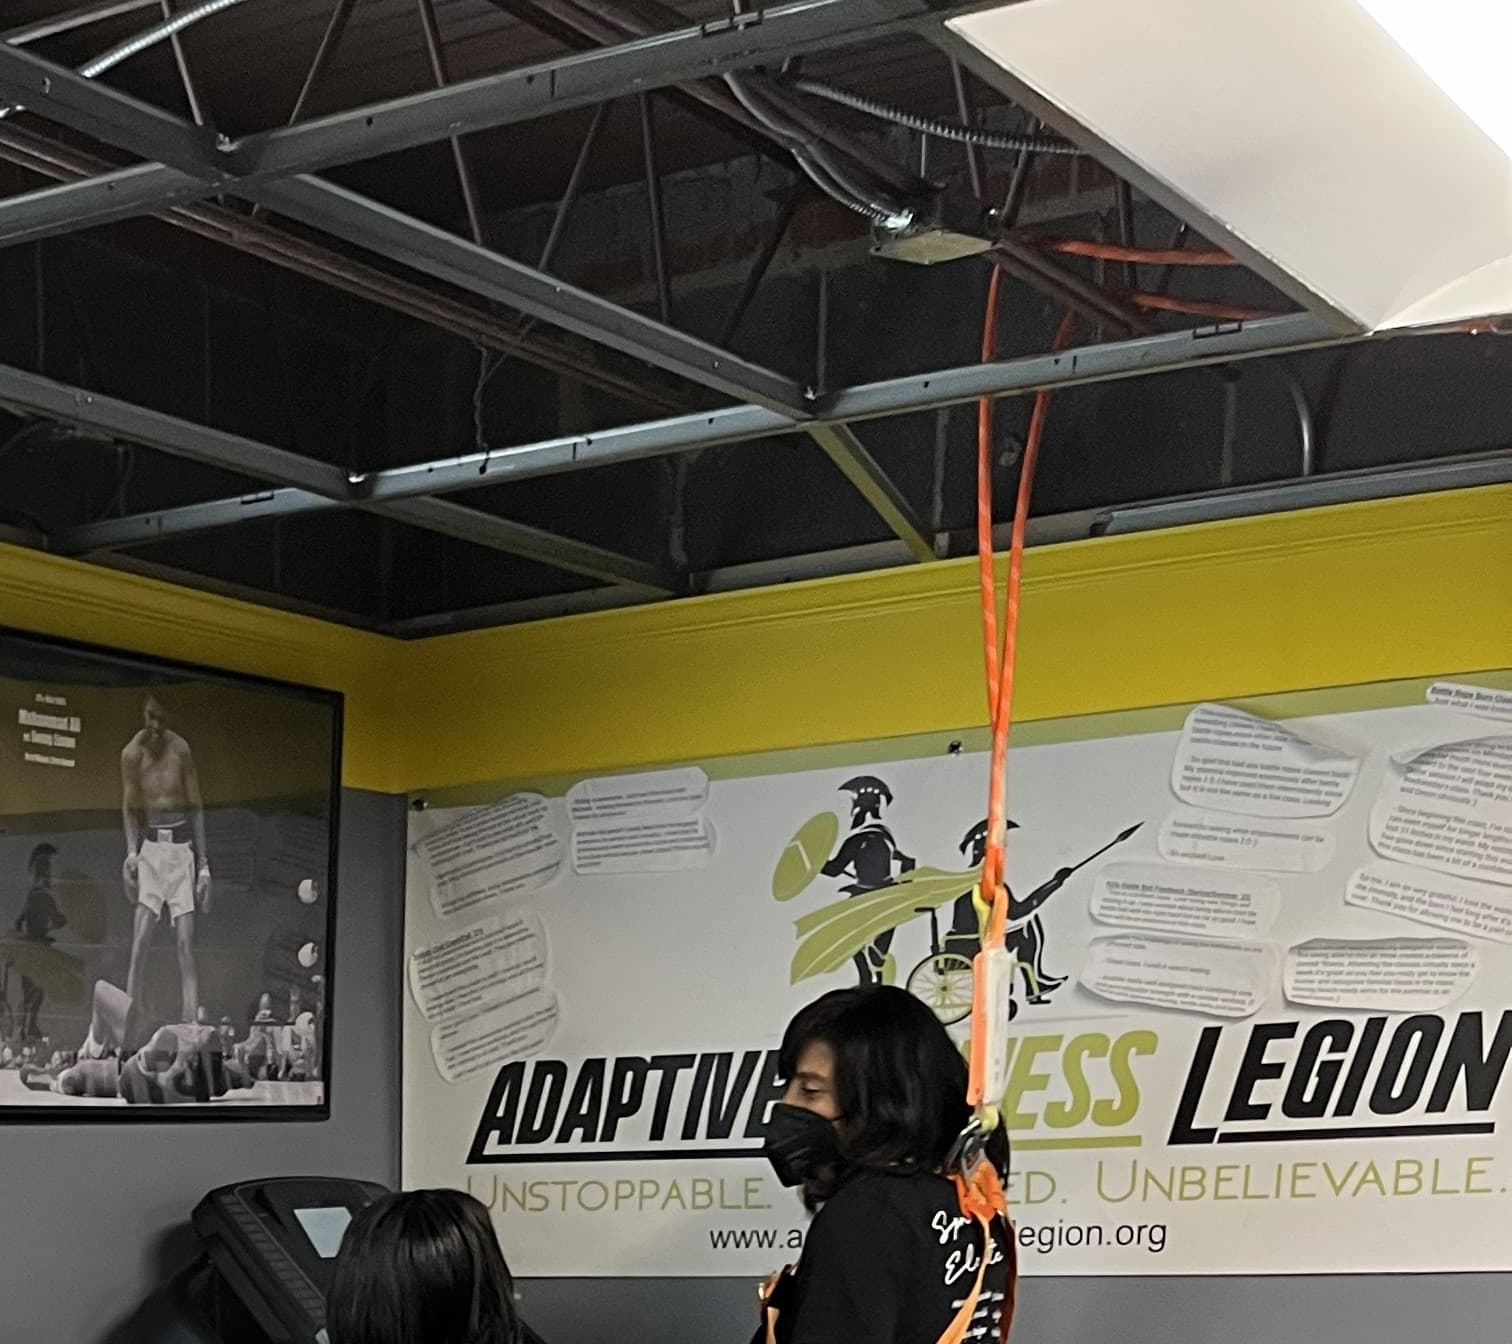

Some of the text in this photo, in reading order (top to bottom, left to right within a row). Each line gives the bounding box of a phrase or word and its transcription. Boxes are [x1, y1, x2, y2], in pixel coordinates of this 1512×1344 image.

[466, 1049, 785, 1164] ADAPTIVE
[1167, 1010, 1512, 1145] LEGION
[1096, 1156, 1507, 1203] UNBELIEVABLE.
